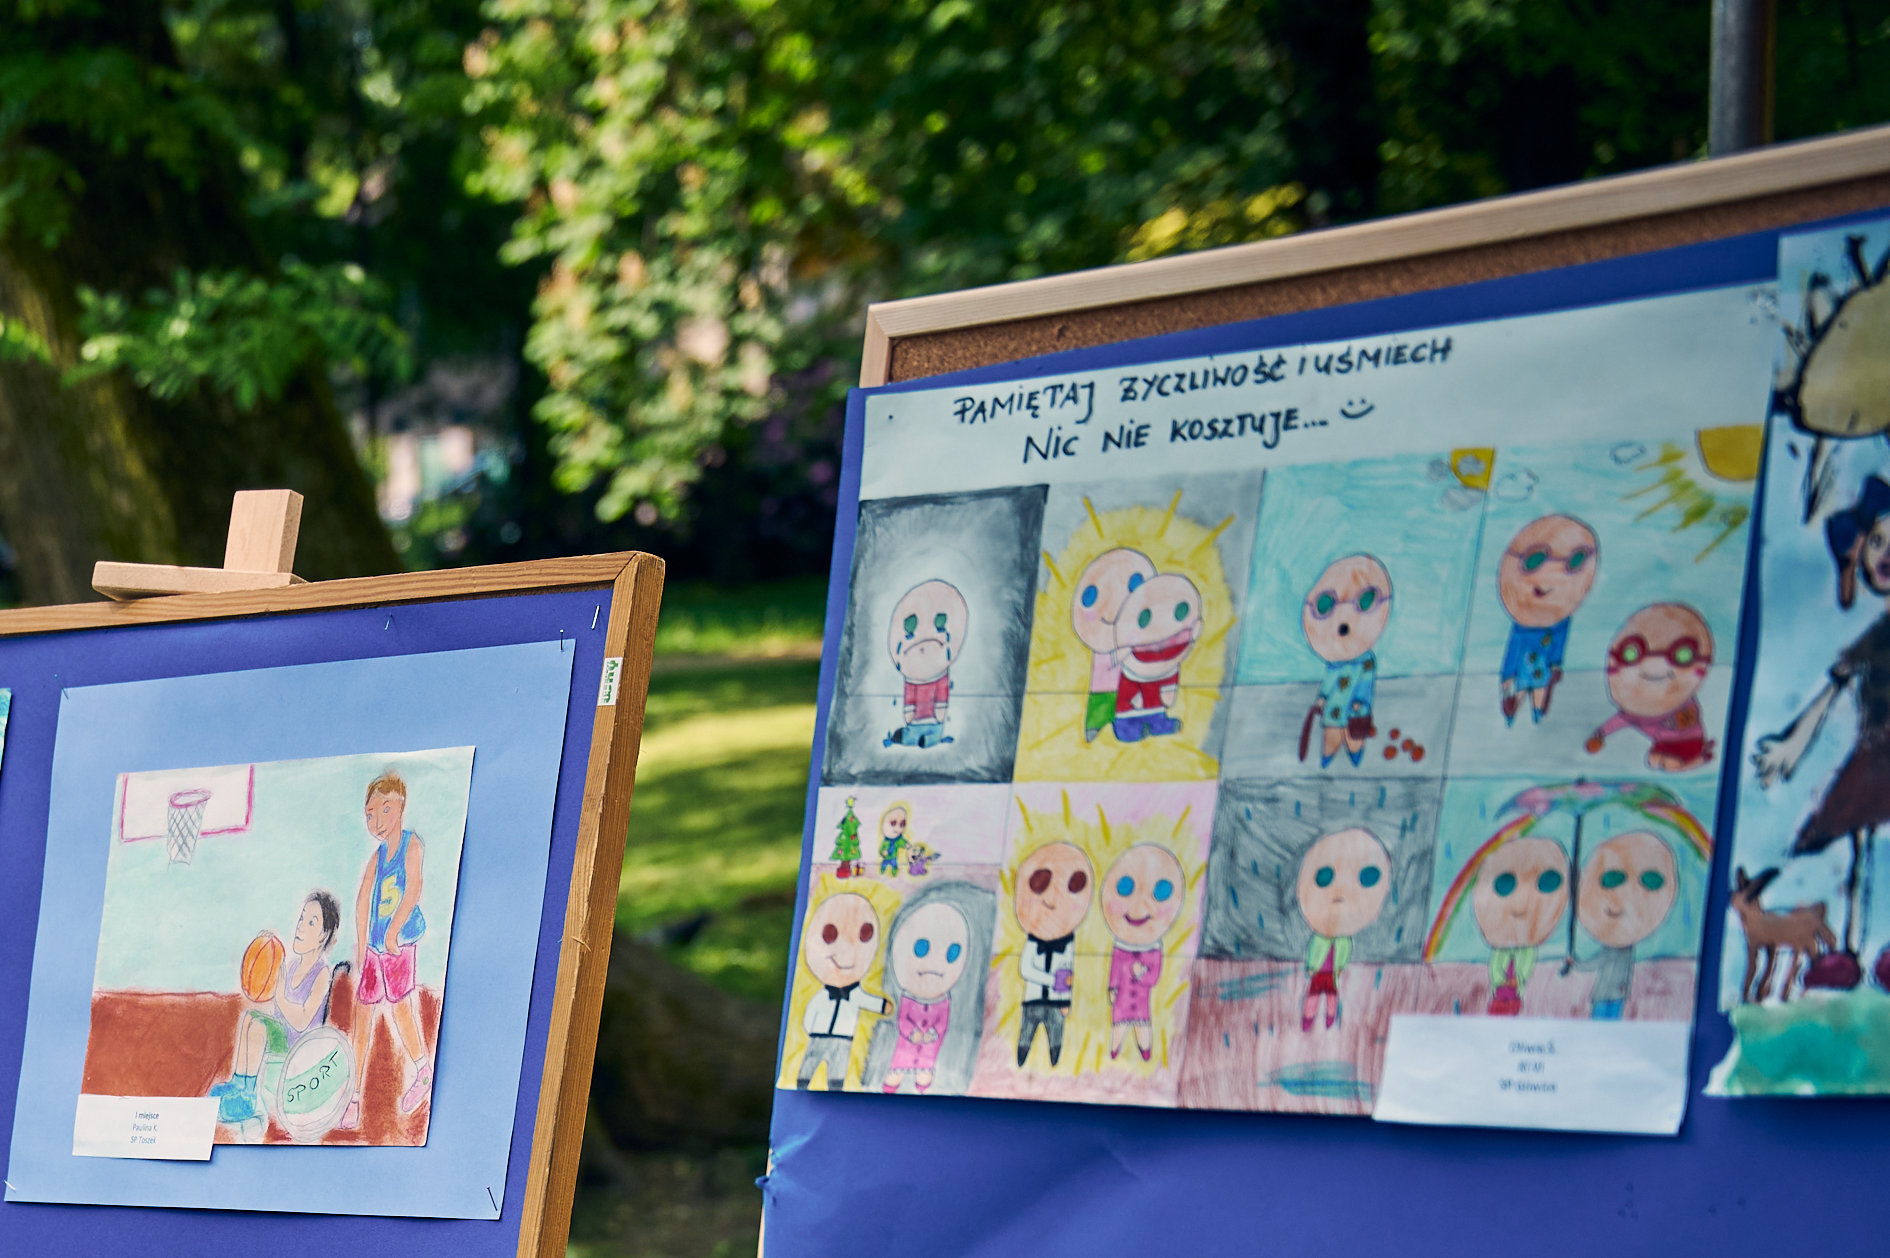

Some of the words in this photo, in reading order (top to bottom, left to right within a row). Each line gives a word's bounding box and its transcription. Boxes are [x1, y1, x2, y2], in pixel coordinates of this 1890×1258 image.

[1314, 336, 1454, 375] UŚMIECH
[377, 874, 400, 918] 5
[287, 1050, 339, 1103] SPORT
[132, 1123, 152, 1132] Paulina
[138, 1112, 160, 1121] miejsce
[130, 1135, 138, 1144] SP
[139, 1136, 157, 1145] Toszek
